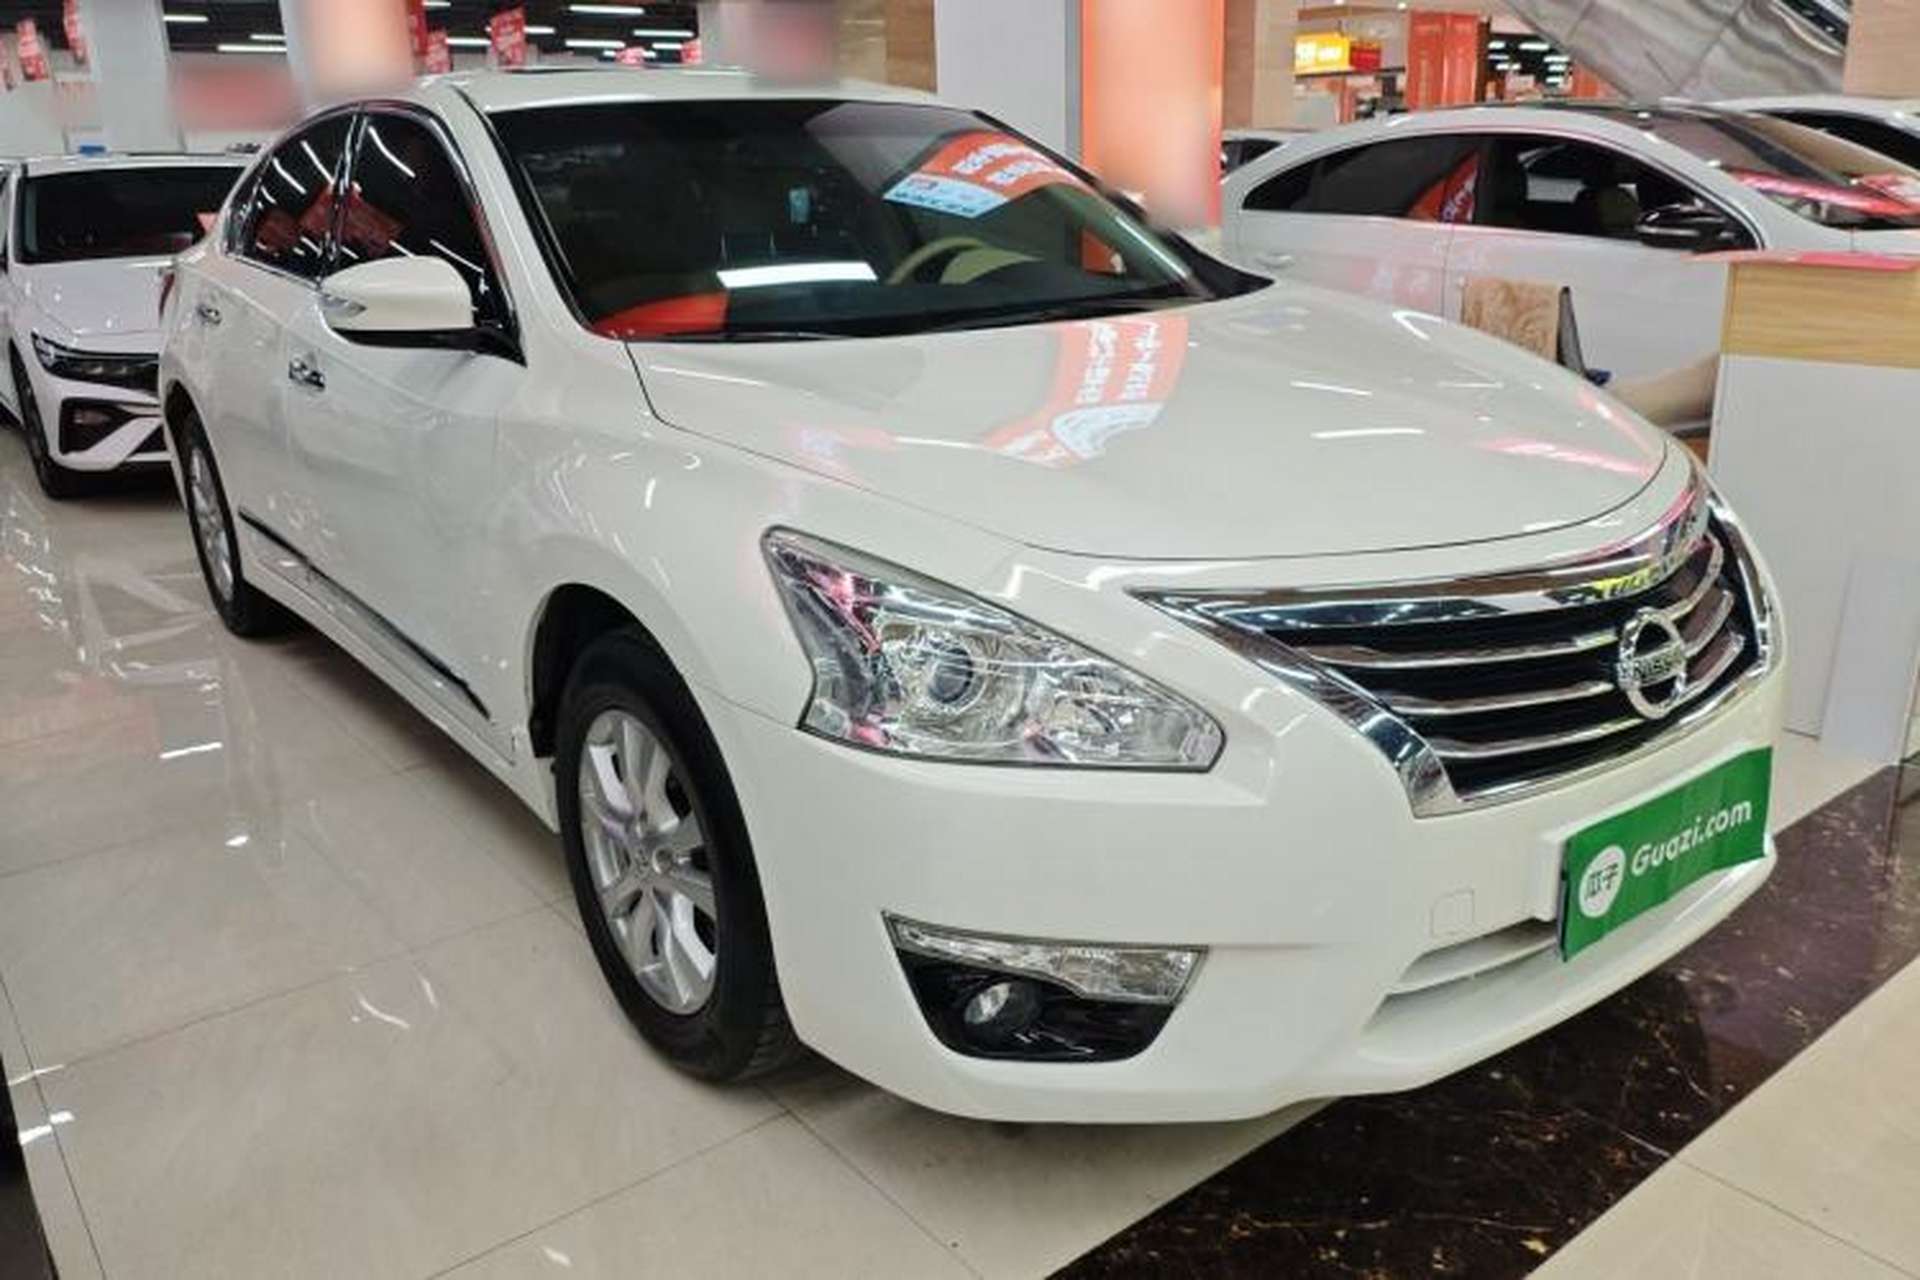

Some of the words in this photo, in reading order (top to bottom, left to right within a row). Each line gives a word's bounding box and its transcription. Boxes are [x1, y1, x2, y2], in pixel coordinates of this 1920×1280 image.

[1632, 648, 1682, 680] NISS
[1631, 801, 1752, 876] Guazi.com
[1586, 862, 1619, 898] 瓜子
